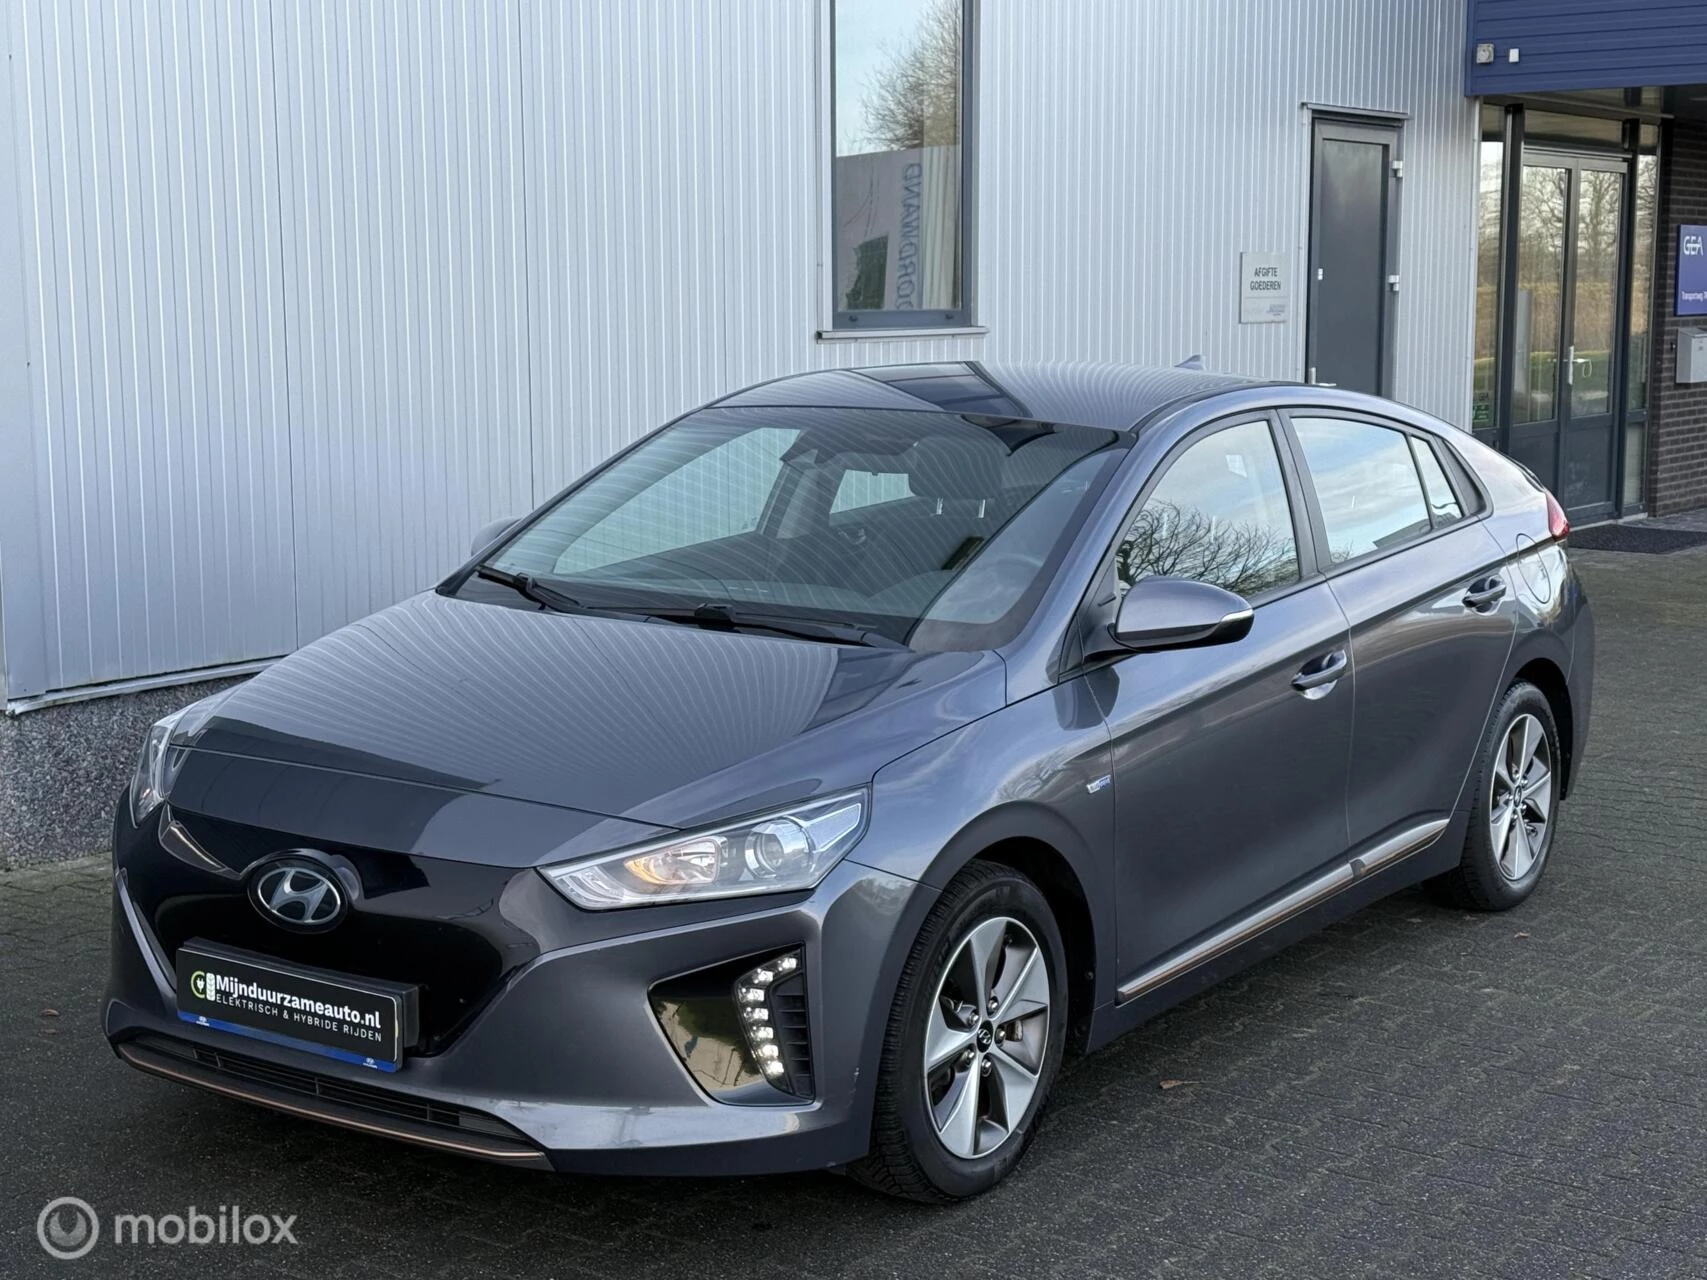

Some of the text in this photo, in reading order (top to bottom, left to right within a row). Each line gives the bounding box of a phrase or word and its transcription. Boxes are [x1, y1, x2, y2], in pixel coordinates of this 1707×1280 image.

[1683, 235, 1704, 256] GEA
[1254, 266, 1278, 277] AFGIFTE
[1250, 280, 1281, 291] GOEDEREN
[215, 974, 381, 1029] Mijnduurzameauto.nl
[215, 993, 382, 1042] ELEKTRISCH & HYBRIDE RIJDEN
